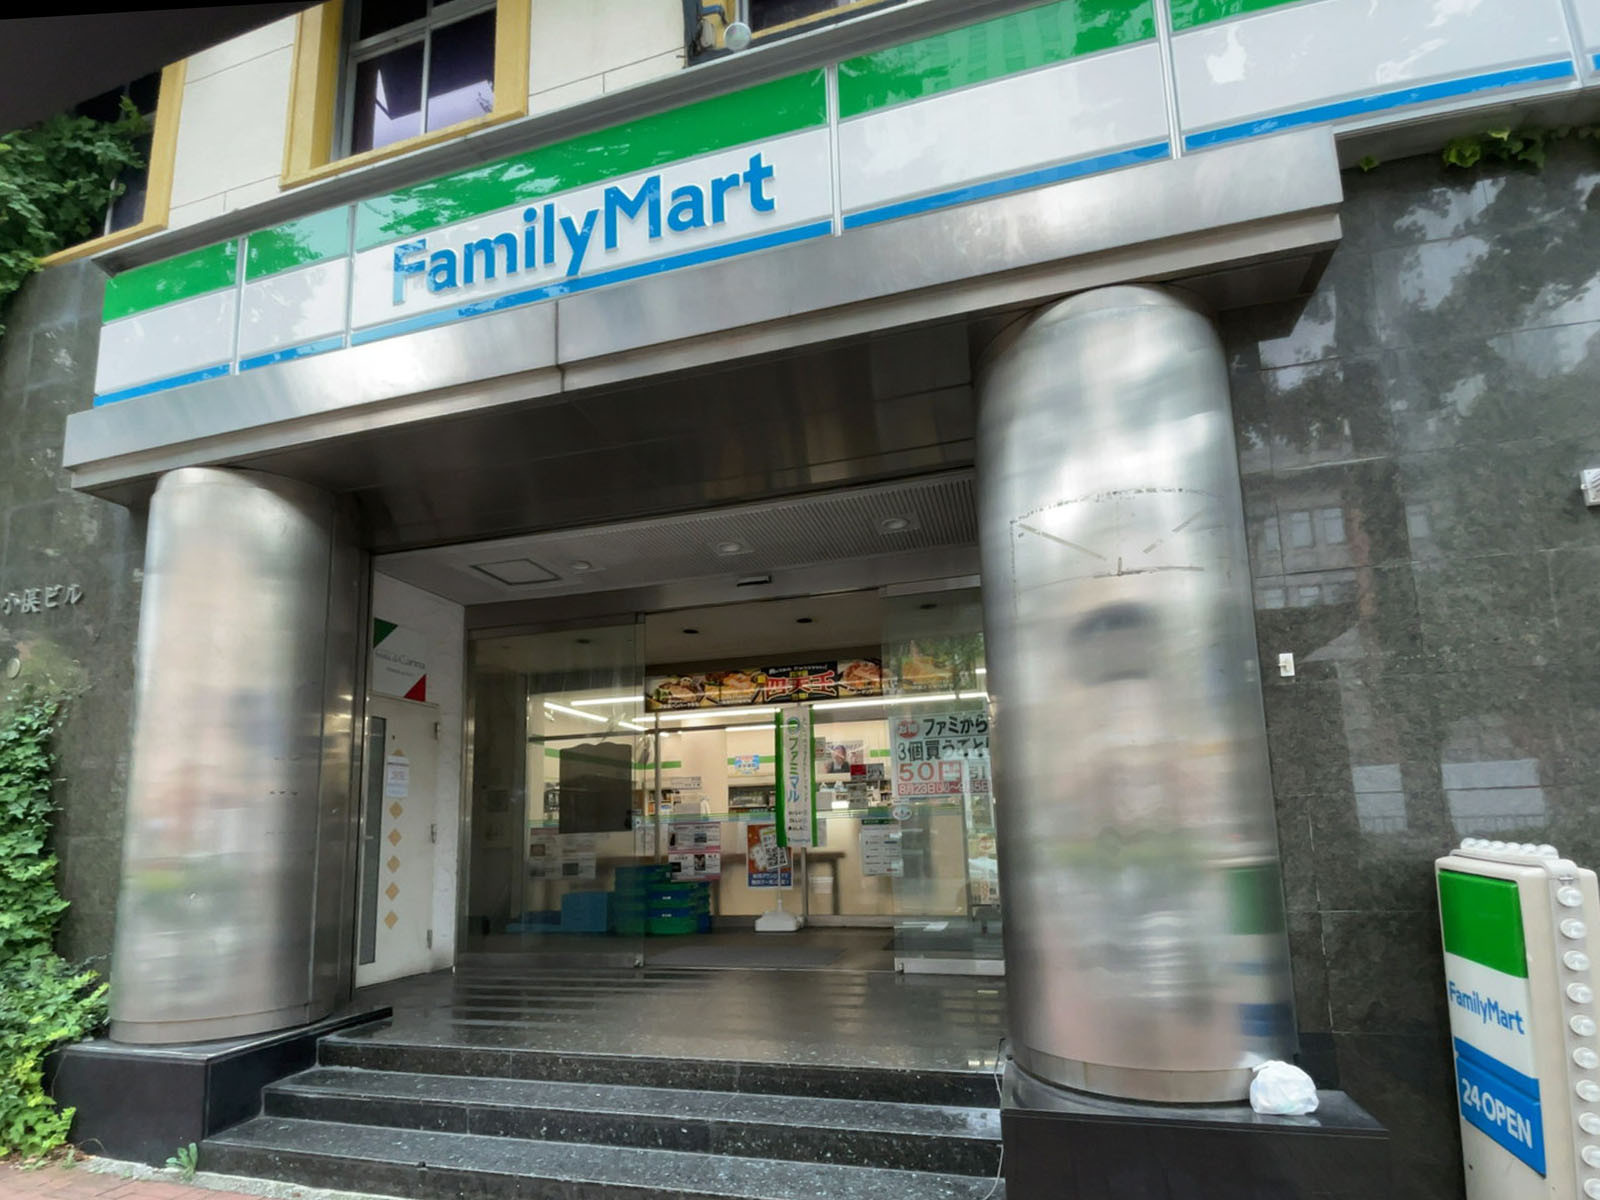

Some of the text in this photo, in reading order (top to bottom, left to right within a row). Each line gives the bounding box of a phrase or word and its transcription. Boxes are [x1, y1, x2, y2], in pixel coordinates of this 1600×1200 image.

[392, 152, 776, 306] FamilyMart
[923, 714, 988, 736] ファミから
[787, 737, 800, 802] ファミマル
[1449, 980, 1525, 1035] FamilyMart
